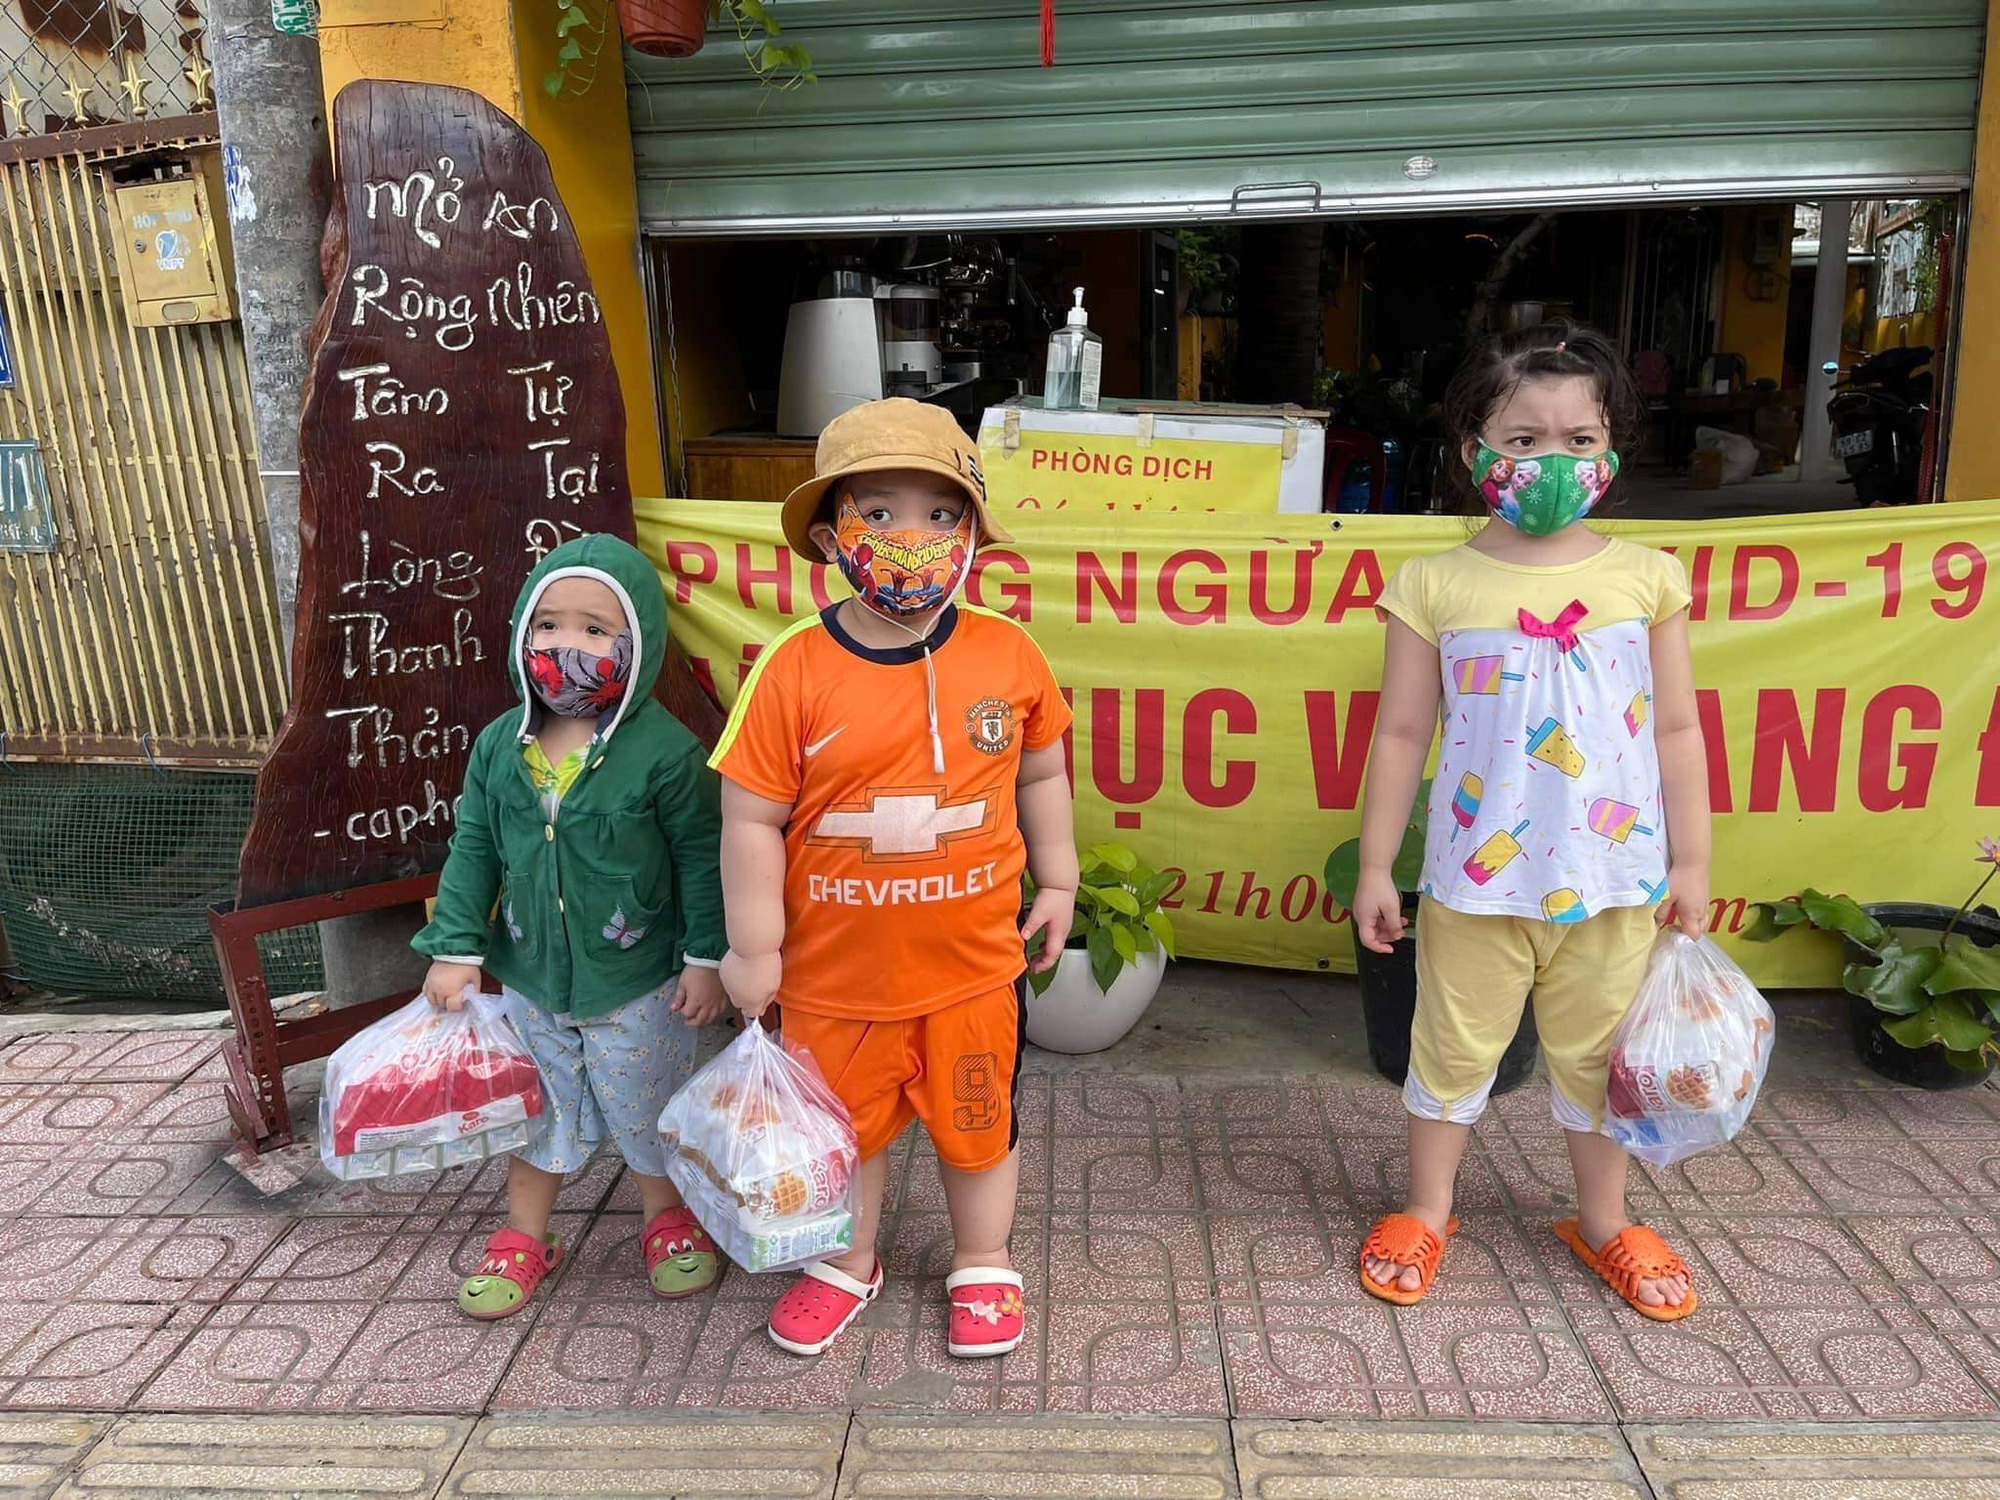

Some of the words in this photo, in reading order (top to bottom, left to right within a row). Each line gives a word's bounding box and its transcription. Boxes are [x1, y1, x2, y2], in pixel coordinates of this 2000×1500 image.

[482, 190, 559, 240] An
[351, 264, 479, 351] Rộng
[337, 362, 449, 421] Tâm
[507, 360, 574, 427] Tự
[365, 440, 445, 498] Ra
[527, 436, 601, 504] Tại
[1031, 446, 1133, 476] PHÒNG
[1142, 456, 1213, 483] DỊCH
[666, 540, 1032, 623] PHG
[1075, 537, 1387, 626] NGỪA
[1660, 541, 1988, 620] ID-19
[328, 608, 487, 679] Thanh
[325, 705, 470, 768] Thản
[808, 860, 998, 907] CHEVROLET
[953, 1051, 1000, 1132] 9
[457, 1115, 490, 1134] Karo
